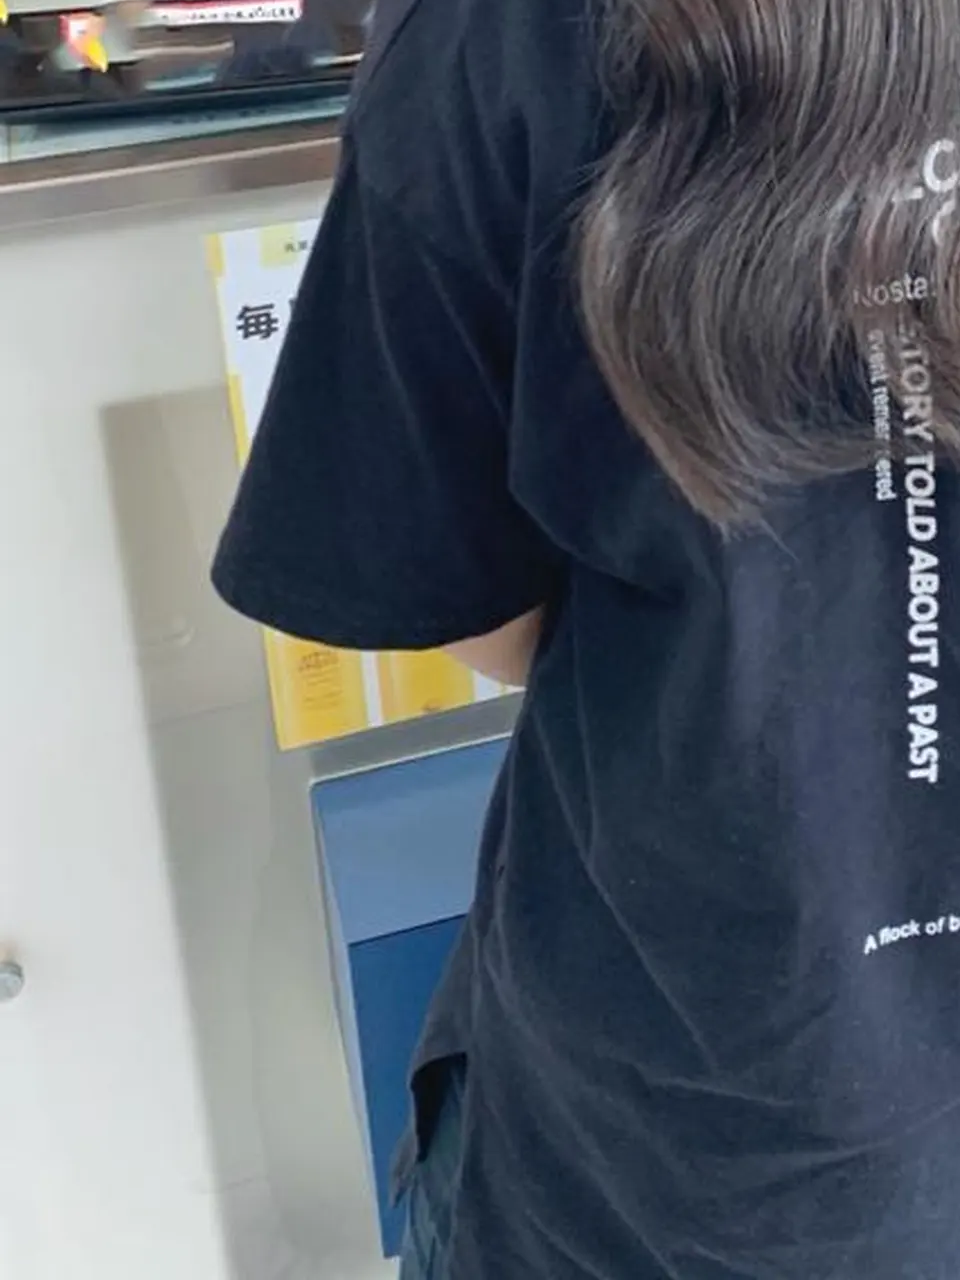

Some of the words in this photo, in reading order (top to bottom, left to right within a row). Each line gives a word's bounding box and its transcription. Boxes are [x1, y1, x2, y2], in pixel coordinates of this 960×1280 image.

[235, 298, 298, 341] 毎
[904, 453, 937, 542] TOLD
[907, 545, 940, 668] ABOUT
[907, 672, 939, 699] A
[907, 704, 940, 783] PAST
[864, 934, 878, 955] A
[879, 920, 920, 946] flock
[925, 916, 947, 936] of
